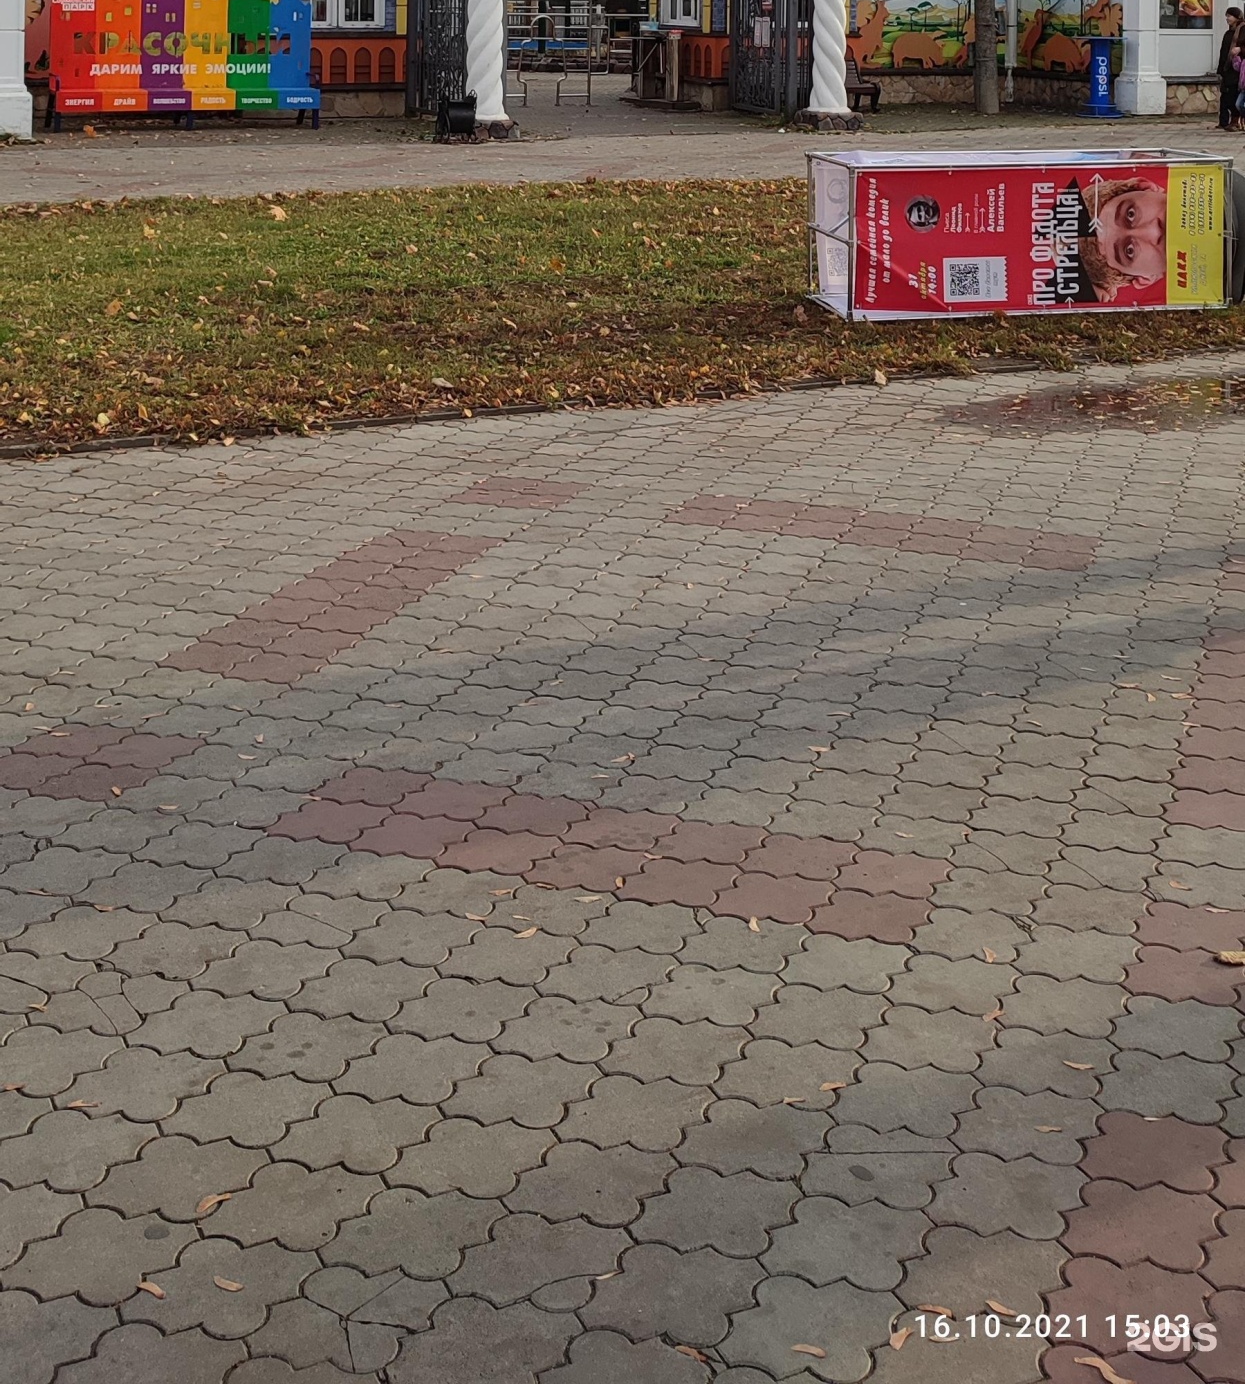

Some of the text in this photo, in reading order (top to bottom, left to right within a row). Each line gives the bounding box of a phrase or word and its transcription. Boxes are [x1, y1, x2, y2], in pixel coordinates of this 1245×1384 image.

[63, 2, 94, 10] ПАРК
[74, 28, 292, 57] КРАСОЧНЫЙ
[90, 63, 271, 76] ДАРИМ ЯРКИЕ ЭМОЦИИ!
[1095, 56, 1108, 97] pepsi
[65, 98, 95, 106] ЭНЕРГИЯ
[113, 97, 136, 106] ДРАЙВ
[200, 96, 227, 104] РАДОСТЬ
[286, 96, 314, 104] БОДРОСТЬ
[987, 188, 996, 233] Алексей
[996, 183, 1005, 233] Васильев
[865, 177, 878, 303] Лучшая семейная комедия
[879, 198, 893, 284] от мало до велик
[1030, 182, 1058, 305] ПРО ФЕДОТА
[908, 274, 918, 288] 31
[918, 262, 929, 300] октября
